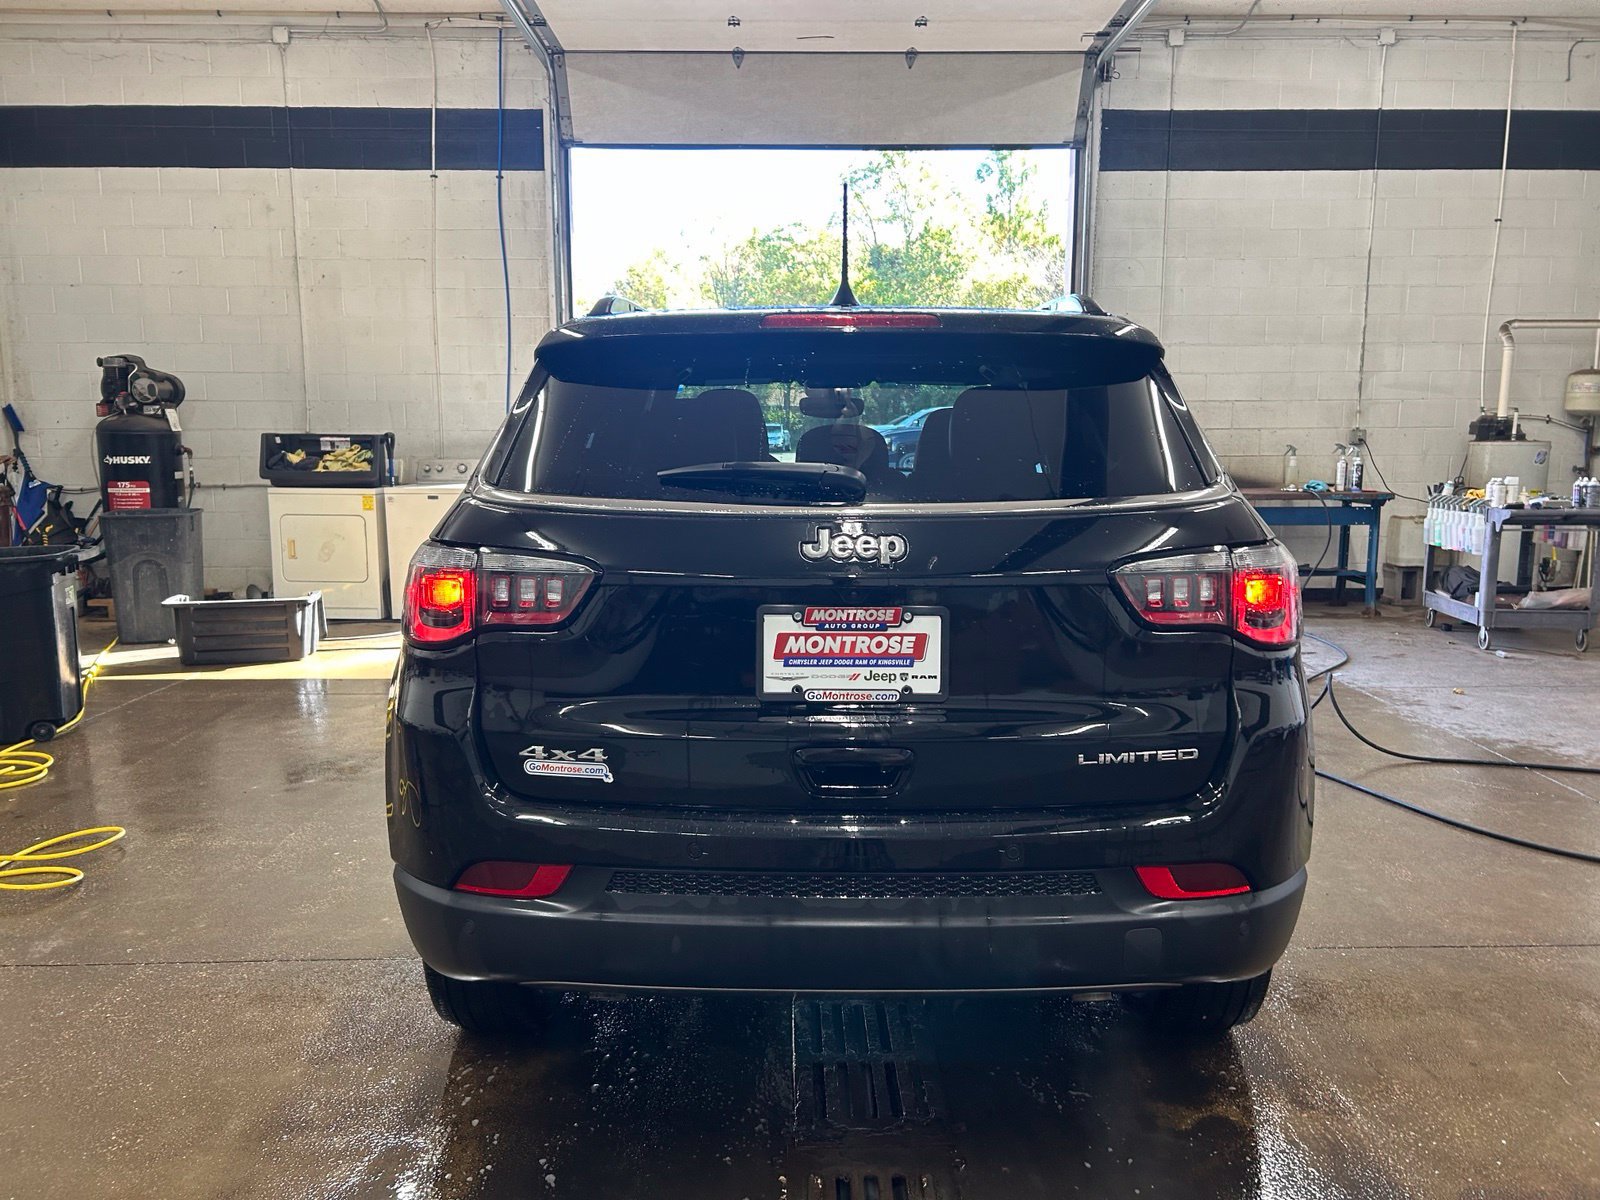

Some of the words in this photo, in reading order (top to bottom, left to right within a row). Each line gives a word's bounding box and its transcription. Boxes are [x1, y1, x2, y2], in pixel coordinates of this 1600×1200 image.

[113, 456, 150, 464] HUSKY
[801, 527, 906, 565] Jeep
[810, 609, 896, 621] MONTROSE
[783, 635, 917, 654] MONTROSE
[863, 670, 897, 684] Jeep
[807, 691, 899, 701] GoMontrose.com
[519, 745, 609, 762] 4x4
[1078, 748, 1199, 765] LIMITED
[529, 762, 604, 775] GoMontrose.com
